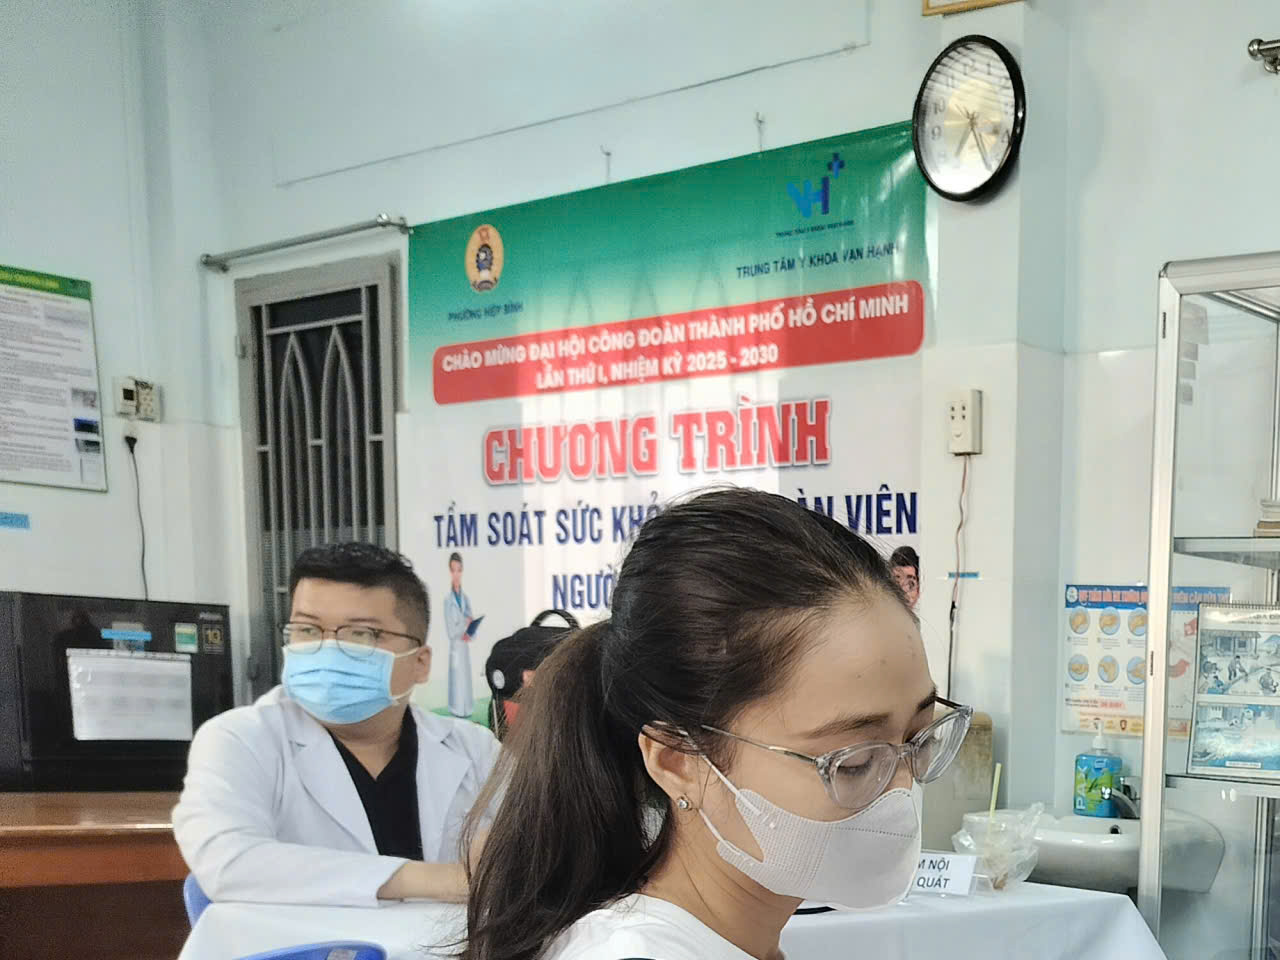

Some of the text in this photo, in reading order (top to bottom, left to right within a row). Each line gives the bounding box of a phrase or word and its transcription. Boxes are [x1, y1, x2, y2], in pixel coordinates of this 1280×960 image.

[737, 263, 770, 278] TRUNG
[773, 259, 796, 271] TÂM
[809, 252, 838, 267] KHOA
[442, 294, 909, 372] CHÀO MỪNG ĐẠI HỘI CÔNG ĐOÀN THÀNH PHỐ HỒ CHÍ MINH
[536, 359, 565, 390] LẦN
[567, 362, 596, 386] THỨ
[610, 356, 659, 384] NHIỆM
[662, 350, 684, 376] KỲ
[687, 352, 727, 372] 2025
[740, 344, 779, 367] 2030
[483, 394, 832, 487] CHƯƠNG TRÌNH
[433, 501, 478, 547] TẦM
[487, 502, 547, 547] SOÁT
[555, 499, 603, 545] SỨC
[845, 484, 918, 535] VIÊN
[916, 875, 950, 889] QUÁT
[928, 857, 950, 872] NỘI
